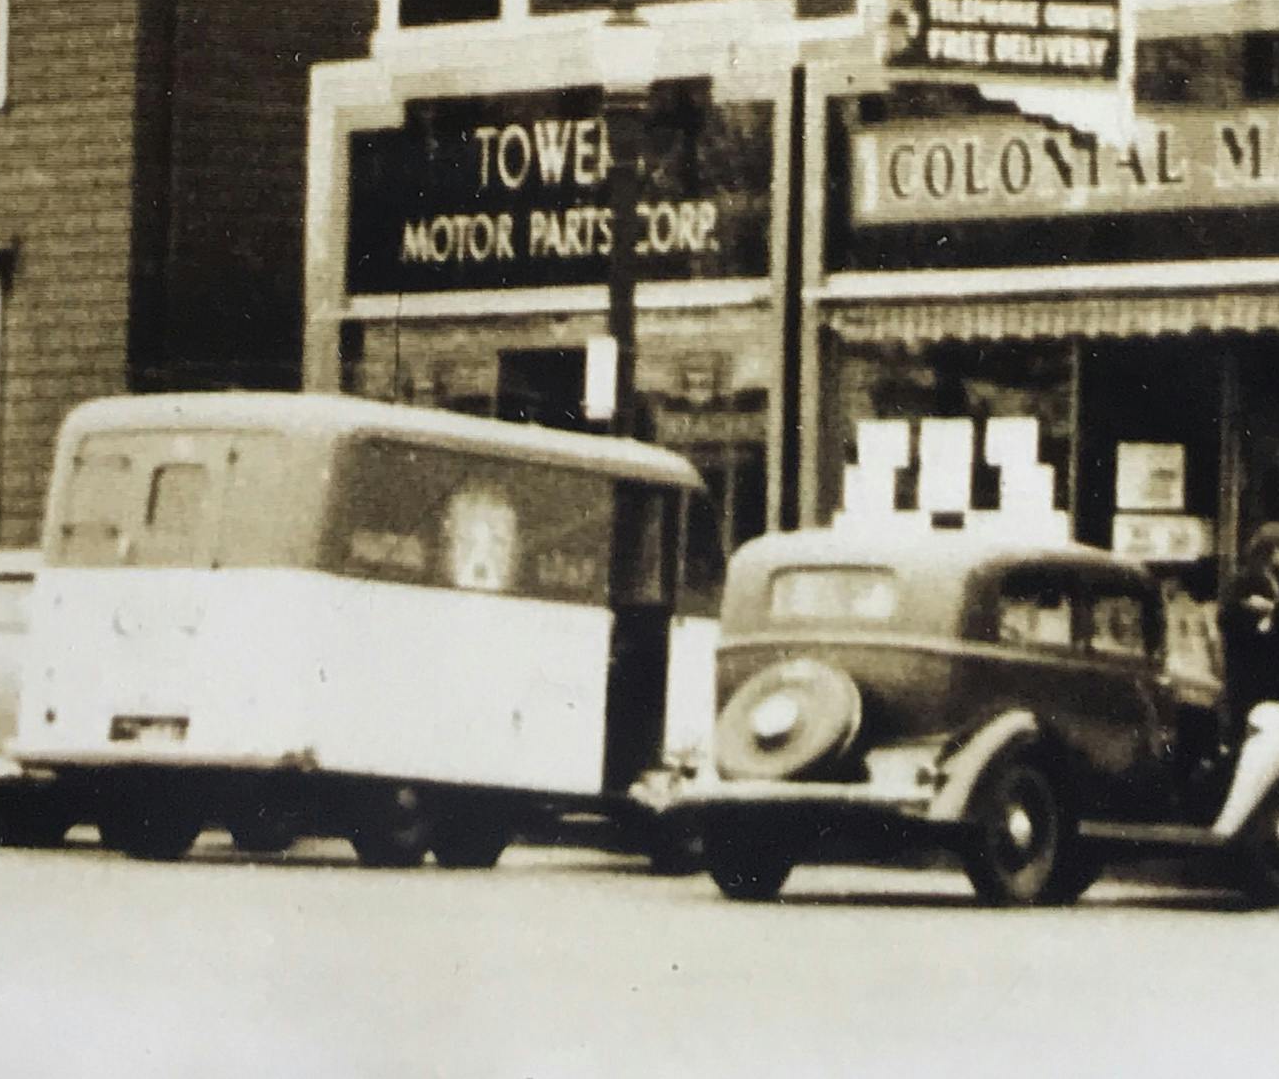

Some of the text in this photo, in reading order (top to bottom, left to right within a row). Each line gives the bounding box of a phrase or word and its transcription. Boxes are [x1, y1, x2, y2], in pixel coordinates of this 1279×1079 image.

[994, 33, 1108, 67] DELIVERY
[888, 130, 1183, 198] COLONIAL
[402, 213, 515, 262] MOTOR
[529, 205, 614, 257] PARTS
